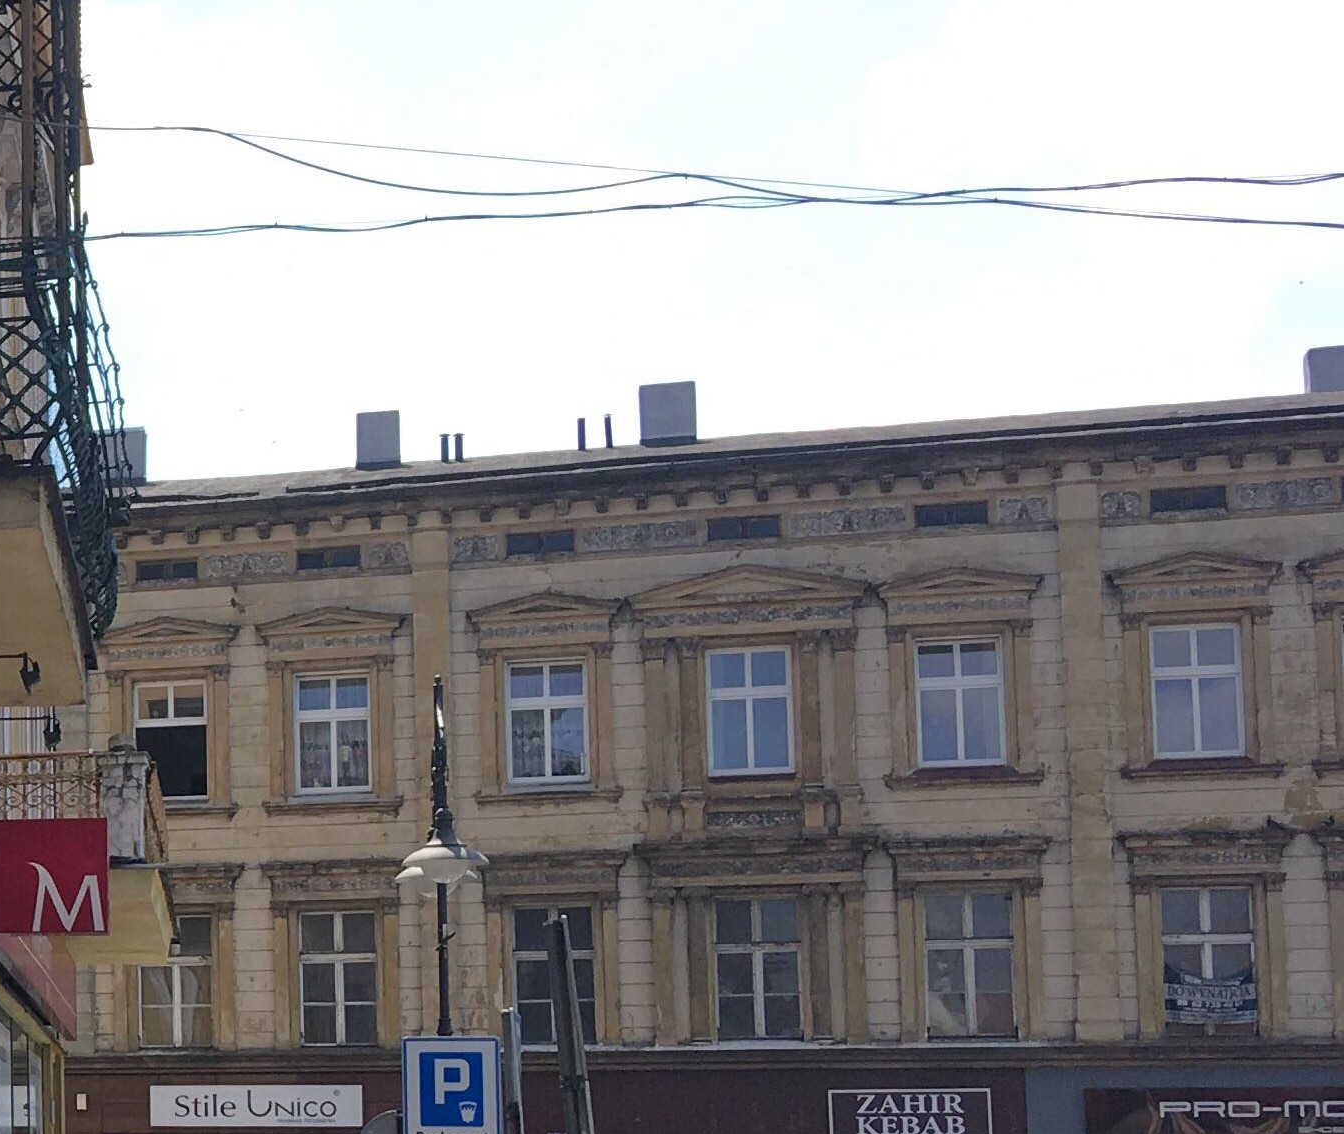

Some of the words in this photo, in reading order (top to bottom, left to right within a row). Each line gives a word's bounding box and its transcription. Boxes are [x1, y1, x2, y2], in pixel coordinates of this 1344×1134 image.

[27, 861, 105, 932] M
[434, 1058, 471, 1104] P
[174, 1094, 237, 1118] Stile
[856, 1094, 965, 1114] ZAHIR
